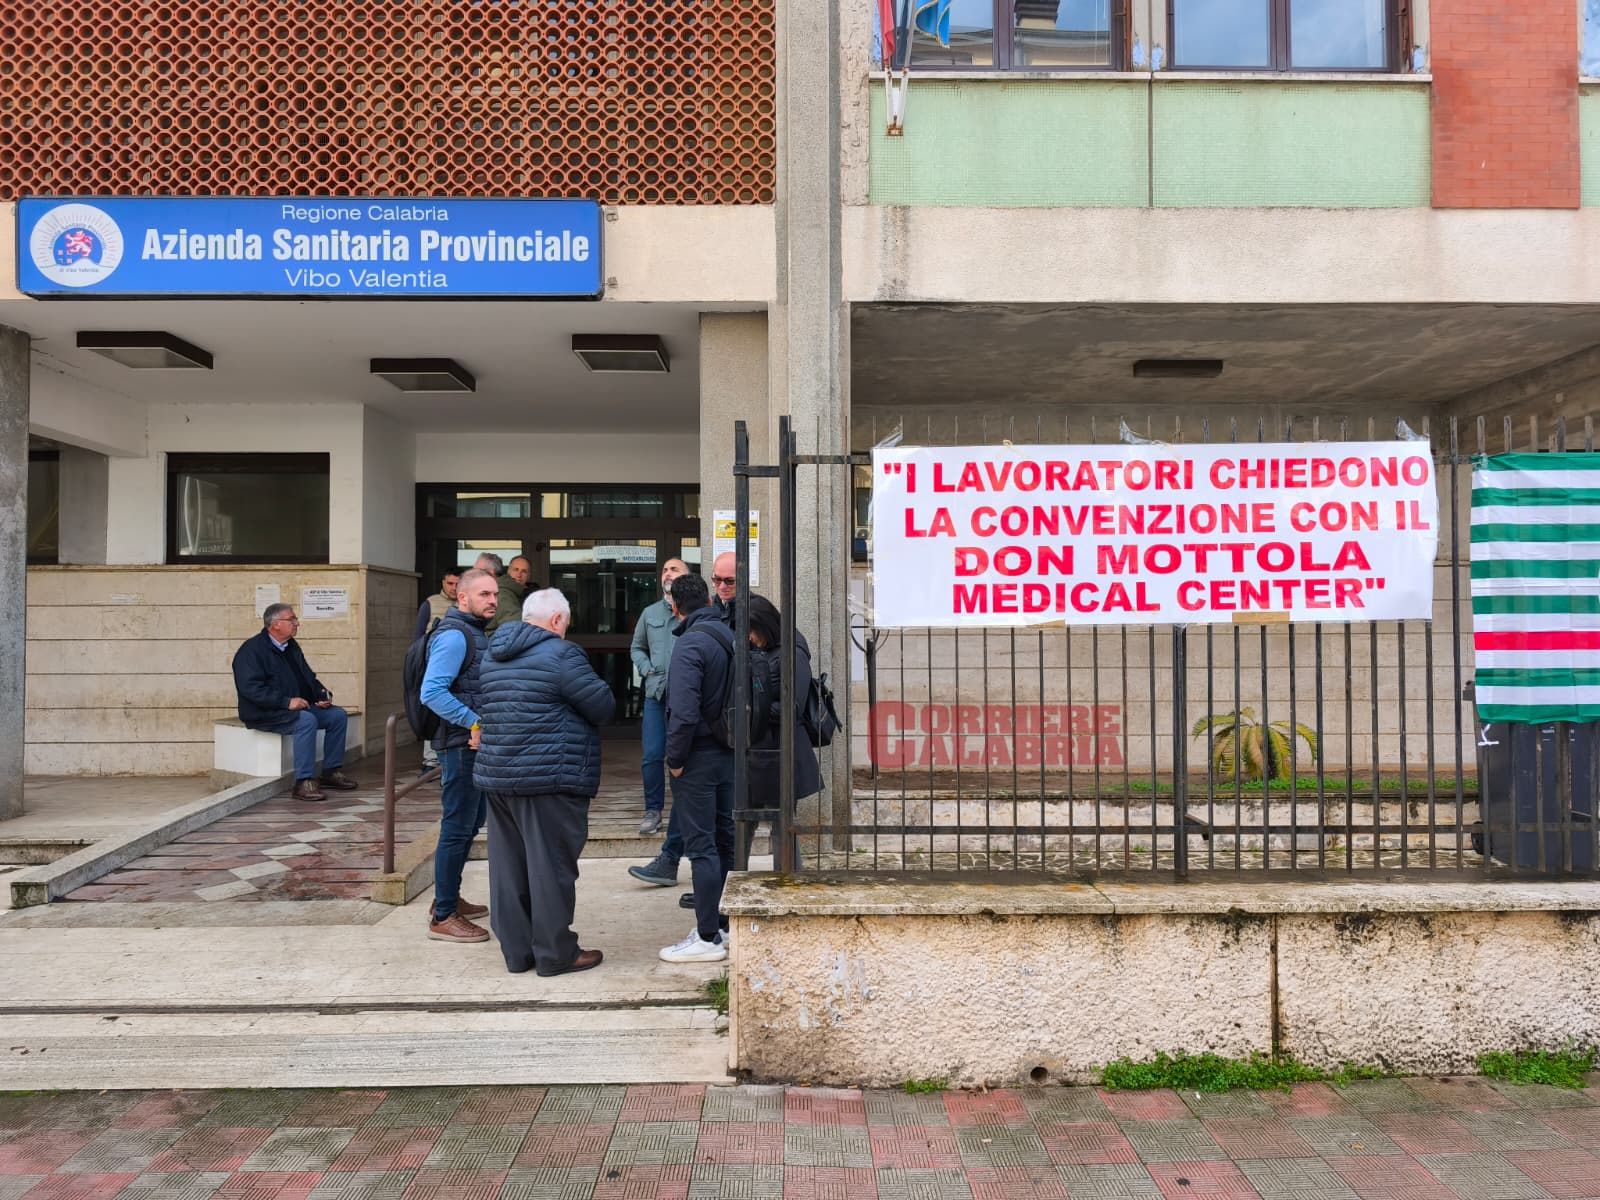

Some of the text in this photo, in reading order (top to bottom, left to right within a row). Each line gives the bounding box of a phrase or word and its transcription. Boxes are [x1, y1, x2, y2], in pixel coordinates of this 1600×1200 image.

[282, 205, 449, 223] Regione Calabria
[141, 228, 262, 261] Azienda
[272, 228, 410, 262] Sanitaria
[420, 229, 589, 262] Provinciale
[285, 269, 448, 288] Vibo Valentia
[932, 459, 1194, 493] LAVORATORI
[1208, 456, 1429, 490] CHIEDONO
[904, 500, 1430, 538] LA CONVENZIONE CON IL
[953, 540, 1372, 577] DON MOTTOLA
[952, 577, 1386, 614] MEDICAL CENTER"
